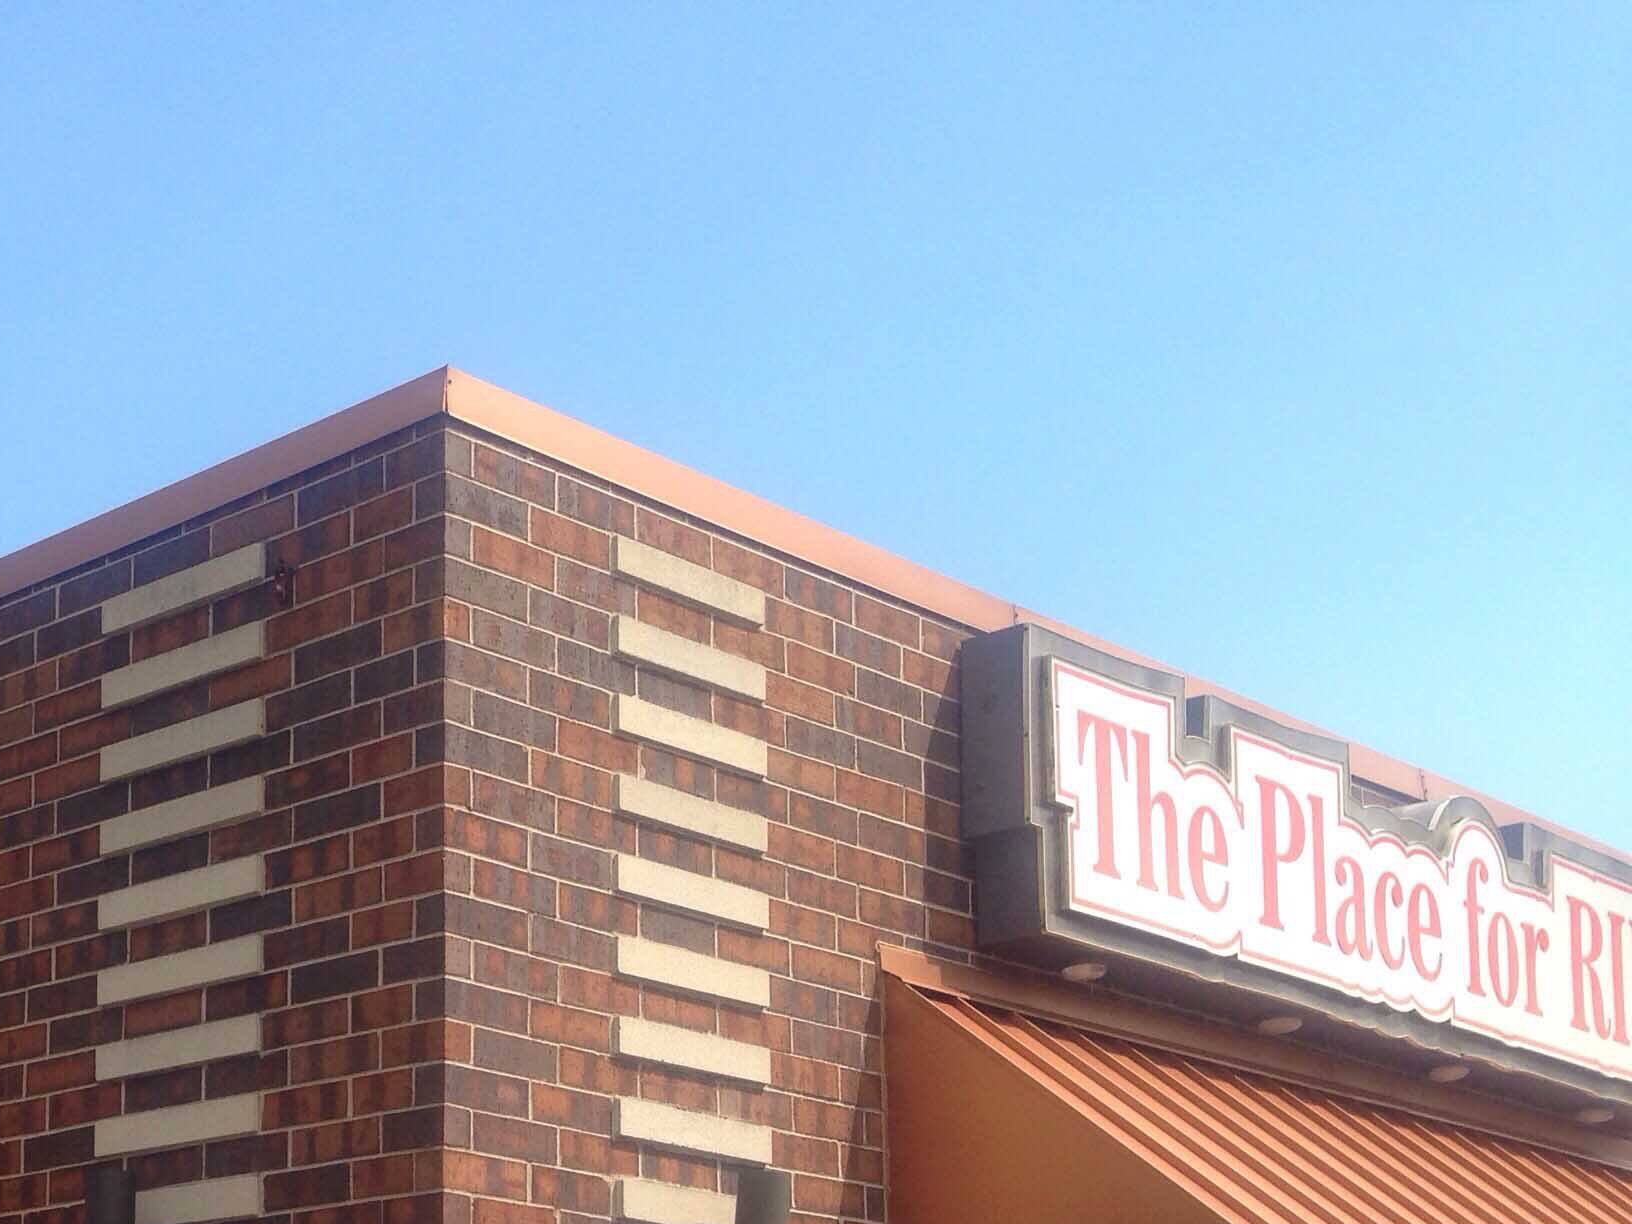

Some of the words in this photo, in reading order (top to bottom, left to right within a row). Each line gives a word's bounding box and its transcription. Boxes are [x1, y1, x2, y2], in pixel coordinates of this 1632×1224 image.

[1077, 709, 1229, 912] The
[1255, 775, 1443, 983] Place
[1463, 856, 1550, 1018] for
[1566, 895, 1632, 1046] RI
